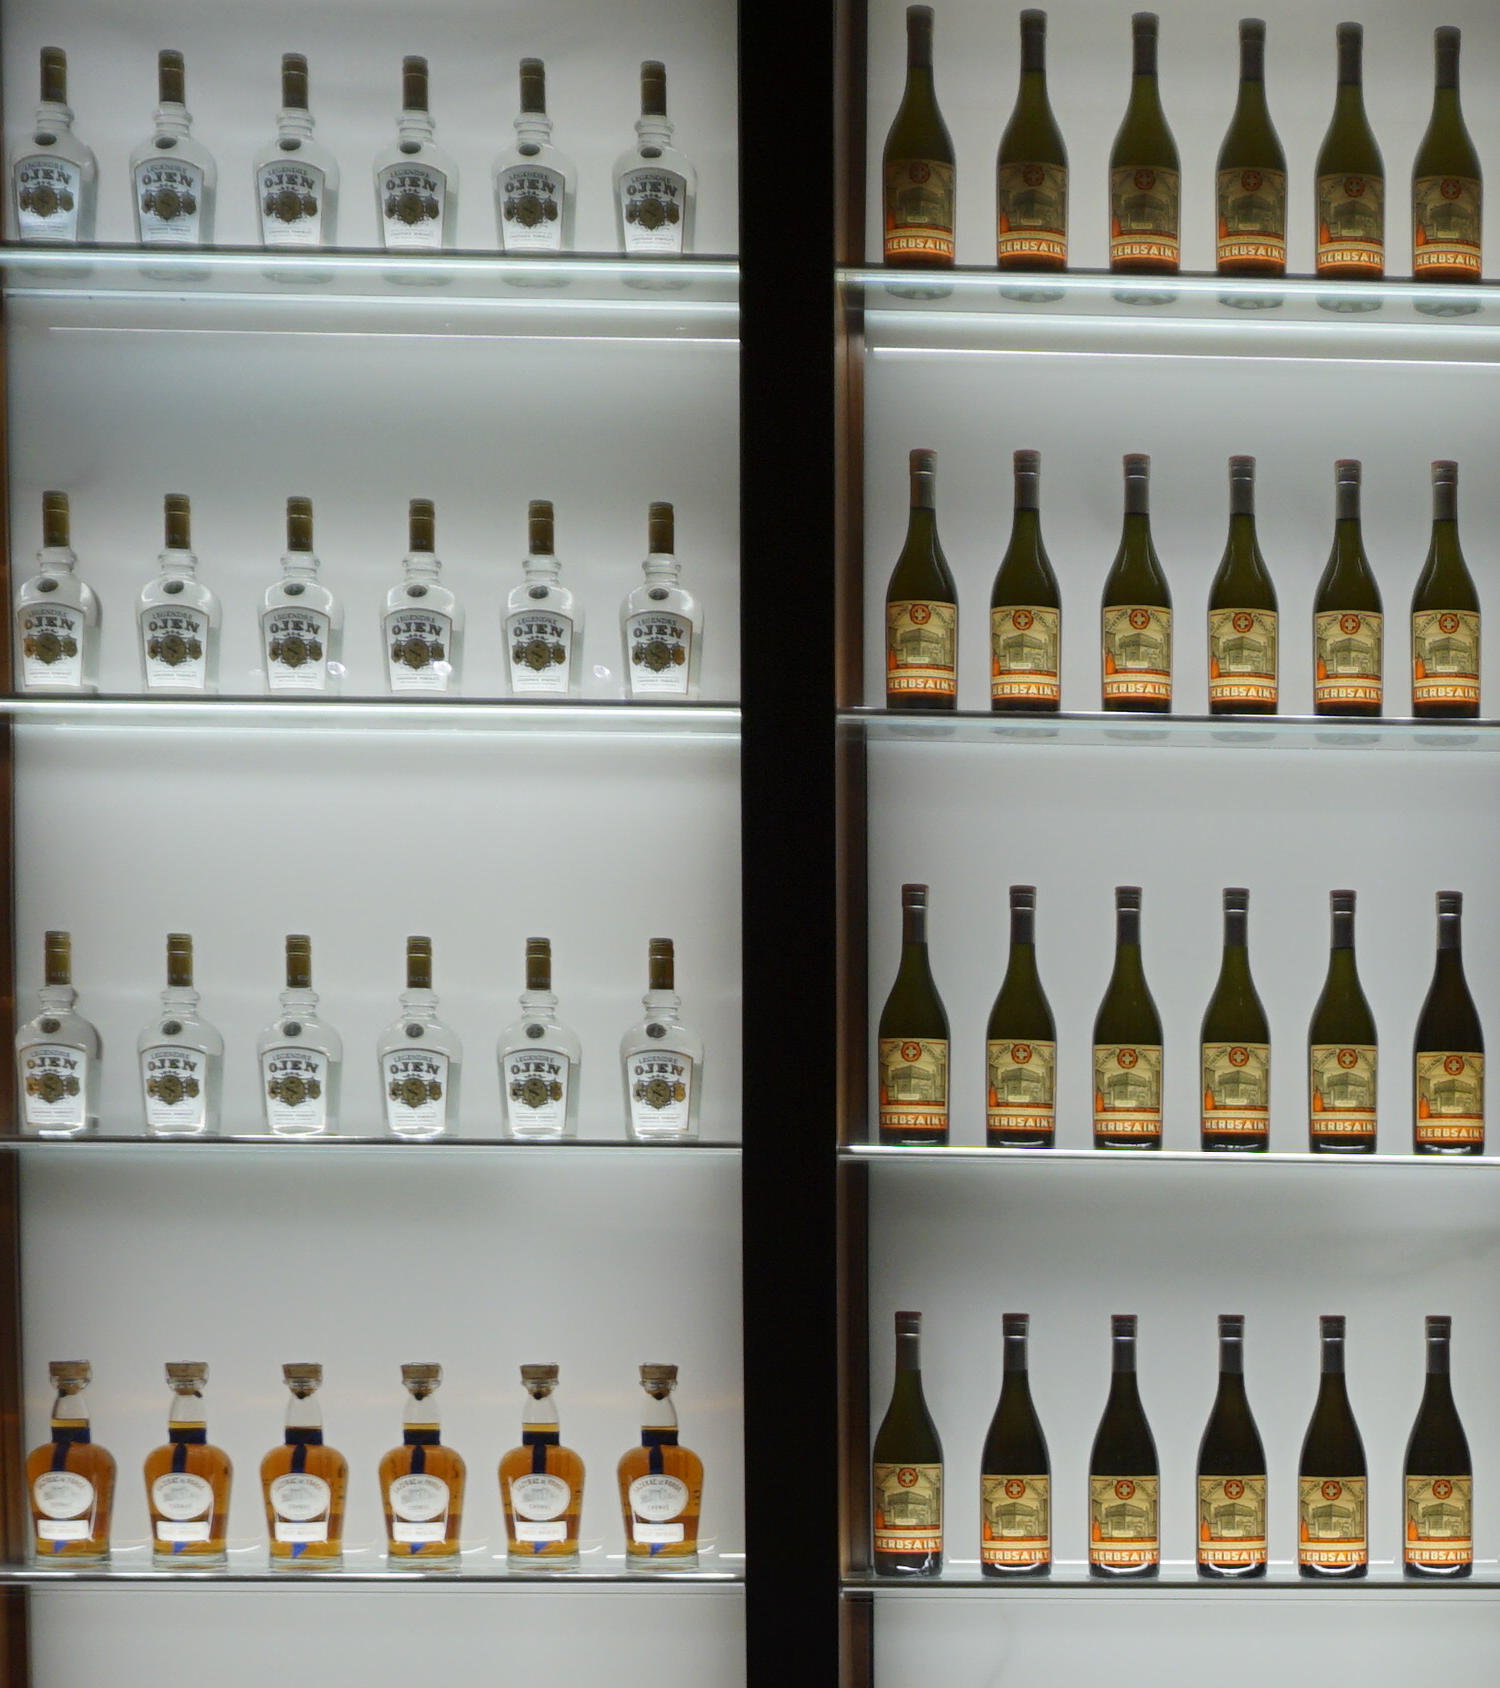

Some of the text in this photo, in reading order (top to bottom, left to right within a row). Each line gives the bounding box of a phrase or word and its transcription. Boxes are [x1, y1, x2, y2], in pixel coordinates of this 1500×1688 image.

[20, 169, 72, 185] OJEN
[143, 172, 194, 188] OJEN
[264, 174, 315, 190] OJEN
[387, 176, 437, 192] OJEN
[504, 178, 556, 194] OJEN
[627, 181, 678, 197] OJEN
[887, 237, 953, 252] HERBSAINT
[1000, 242, 1067, 255] HERBSAINT
[1112, 244, 1179, 259] HERBSAINT
[1219, 245, 1284, 260] HERBSAINT
[1321, 252, 1384, 266] HERBSAINT
[1417, 253, 1481, 267] HERBSAINT
[24, 615, 75, 630] OJEN
[148, 618, 200, 633] OJEN
[269, 619, 320, 634] OJEN
[392, 622, 443, 637] OJEN
[513, 623, 564, 637] OJEN
[633, 624, 683, 639] OJEN
[888, 679, 955, 691] HERBSAINT
[992, 685, 1057, 696] HERBSAINT
[1106, 684, 1171, 696] HERBSAINT
[1212, 687, 1276, 699] HERBSAINT
[1318, 688, 1382, 699] HERBSAINT
[1416, 688, 1479, 699] HERBSAINT
[27, 1056, 78, 1070] OJEN
[148, 1059, 197, 1072] OJEN
[268, 1059, 319, 1073] OJEN
[390, 1061, 440, 1074] OJEN
[510, 1062, 561, 1075] OJEN
[635, 1063, 685, 1076] OJEN
[882, 1115, 945, 1127] HERBSAINT
[990, 1117, 1054, 1128] HERBSAINT
[1096, 1122, 1161, 1133] HERBSAINT
[1205, 1121, 1269, 1131] HERBSAINT
[1314, 1122, 1376, 1132] HERBSAINT
[1420, 1128, 1484, 1138] HERBSAINT
[876, 1539, 941, 1549] HERBSAINT
[984, 1551, 1048, 1561] HERBSAINT
[1092, 1550, 1158, 1561] HERBSAINT
[1201, 1550, 1265, 1561] HERBSAINT
[1300, 1551, 1365, 1562] HERBSAINT
[1408, 1551, 1471, 1561] HERBSAINT
